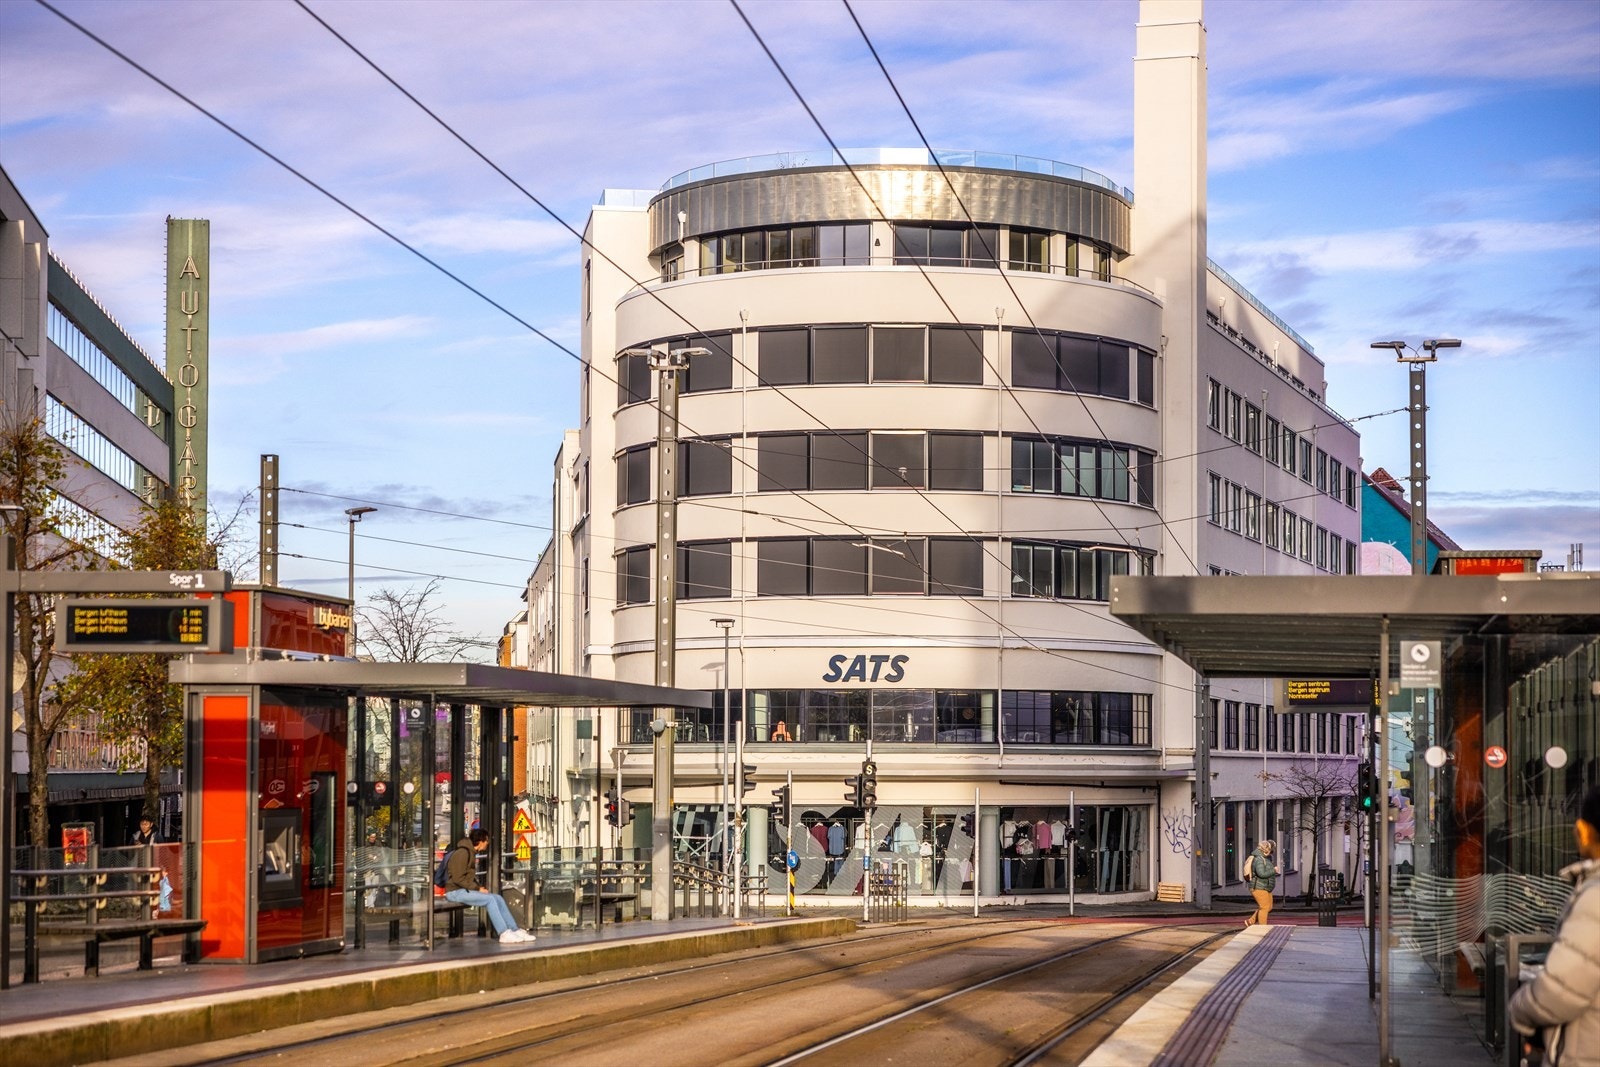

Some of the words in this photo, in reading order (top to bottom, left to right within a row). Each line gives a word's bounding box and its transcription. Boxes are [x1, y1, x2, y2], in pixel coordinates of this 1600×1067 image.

[169, 572, 194, 586] Spor
[195, 574, 205, 588] 1
[319, 606, 351, 630] bybanen
[822, 654, 910, 682] SATS
